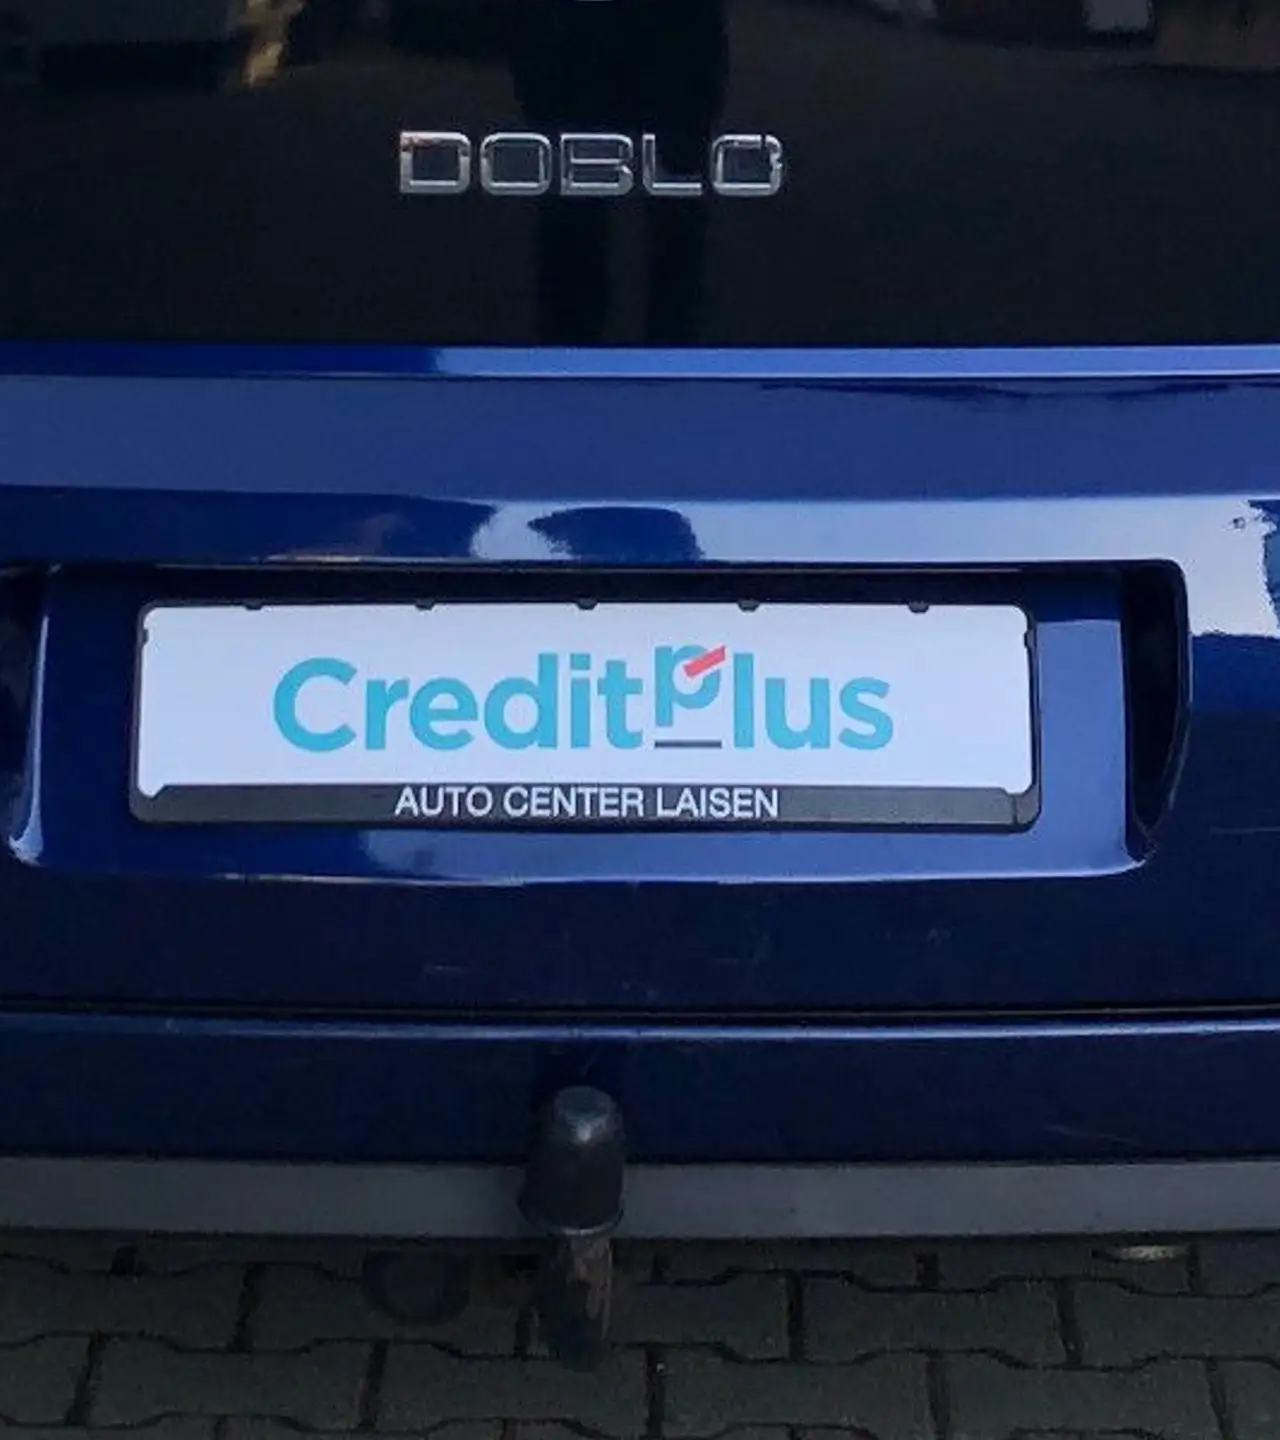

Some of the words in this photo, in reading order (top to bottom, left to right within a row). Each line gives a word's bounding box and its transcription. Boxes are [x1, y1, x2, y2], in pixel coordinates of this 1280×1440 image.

[273, 645, 894, 752] CreditPlus
[394, 785, 494, 817] AUTO
[503, 785, 644, 818] CENTER
[656, 786, 779, 818] LAISEN
